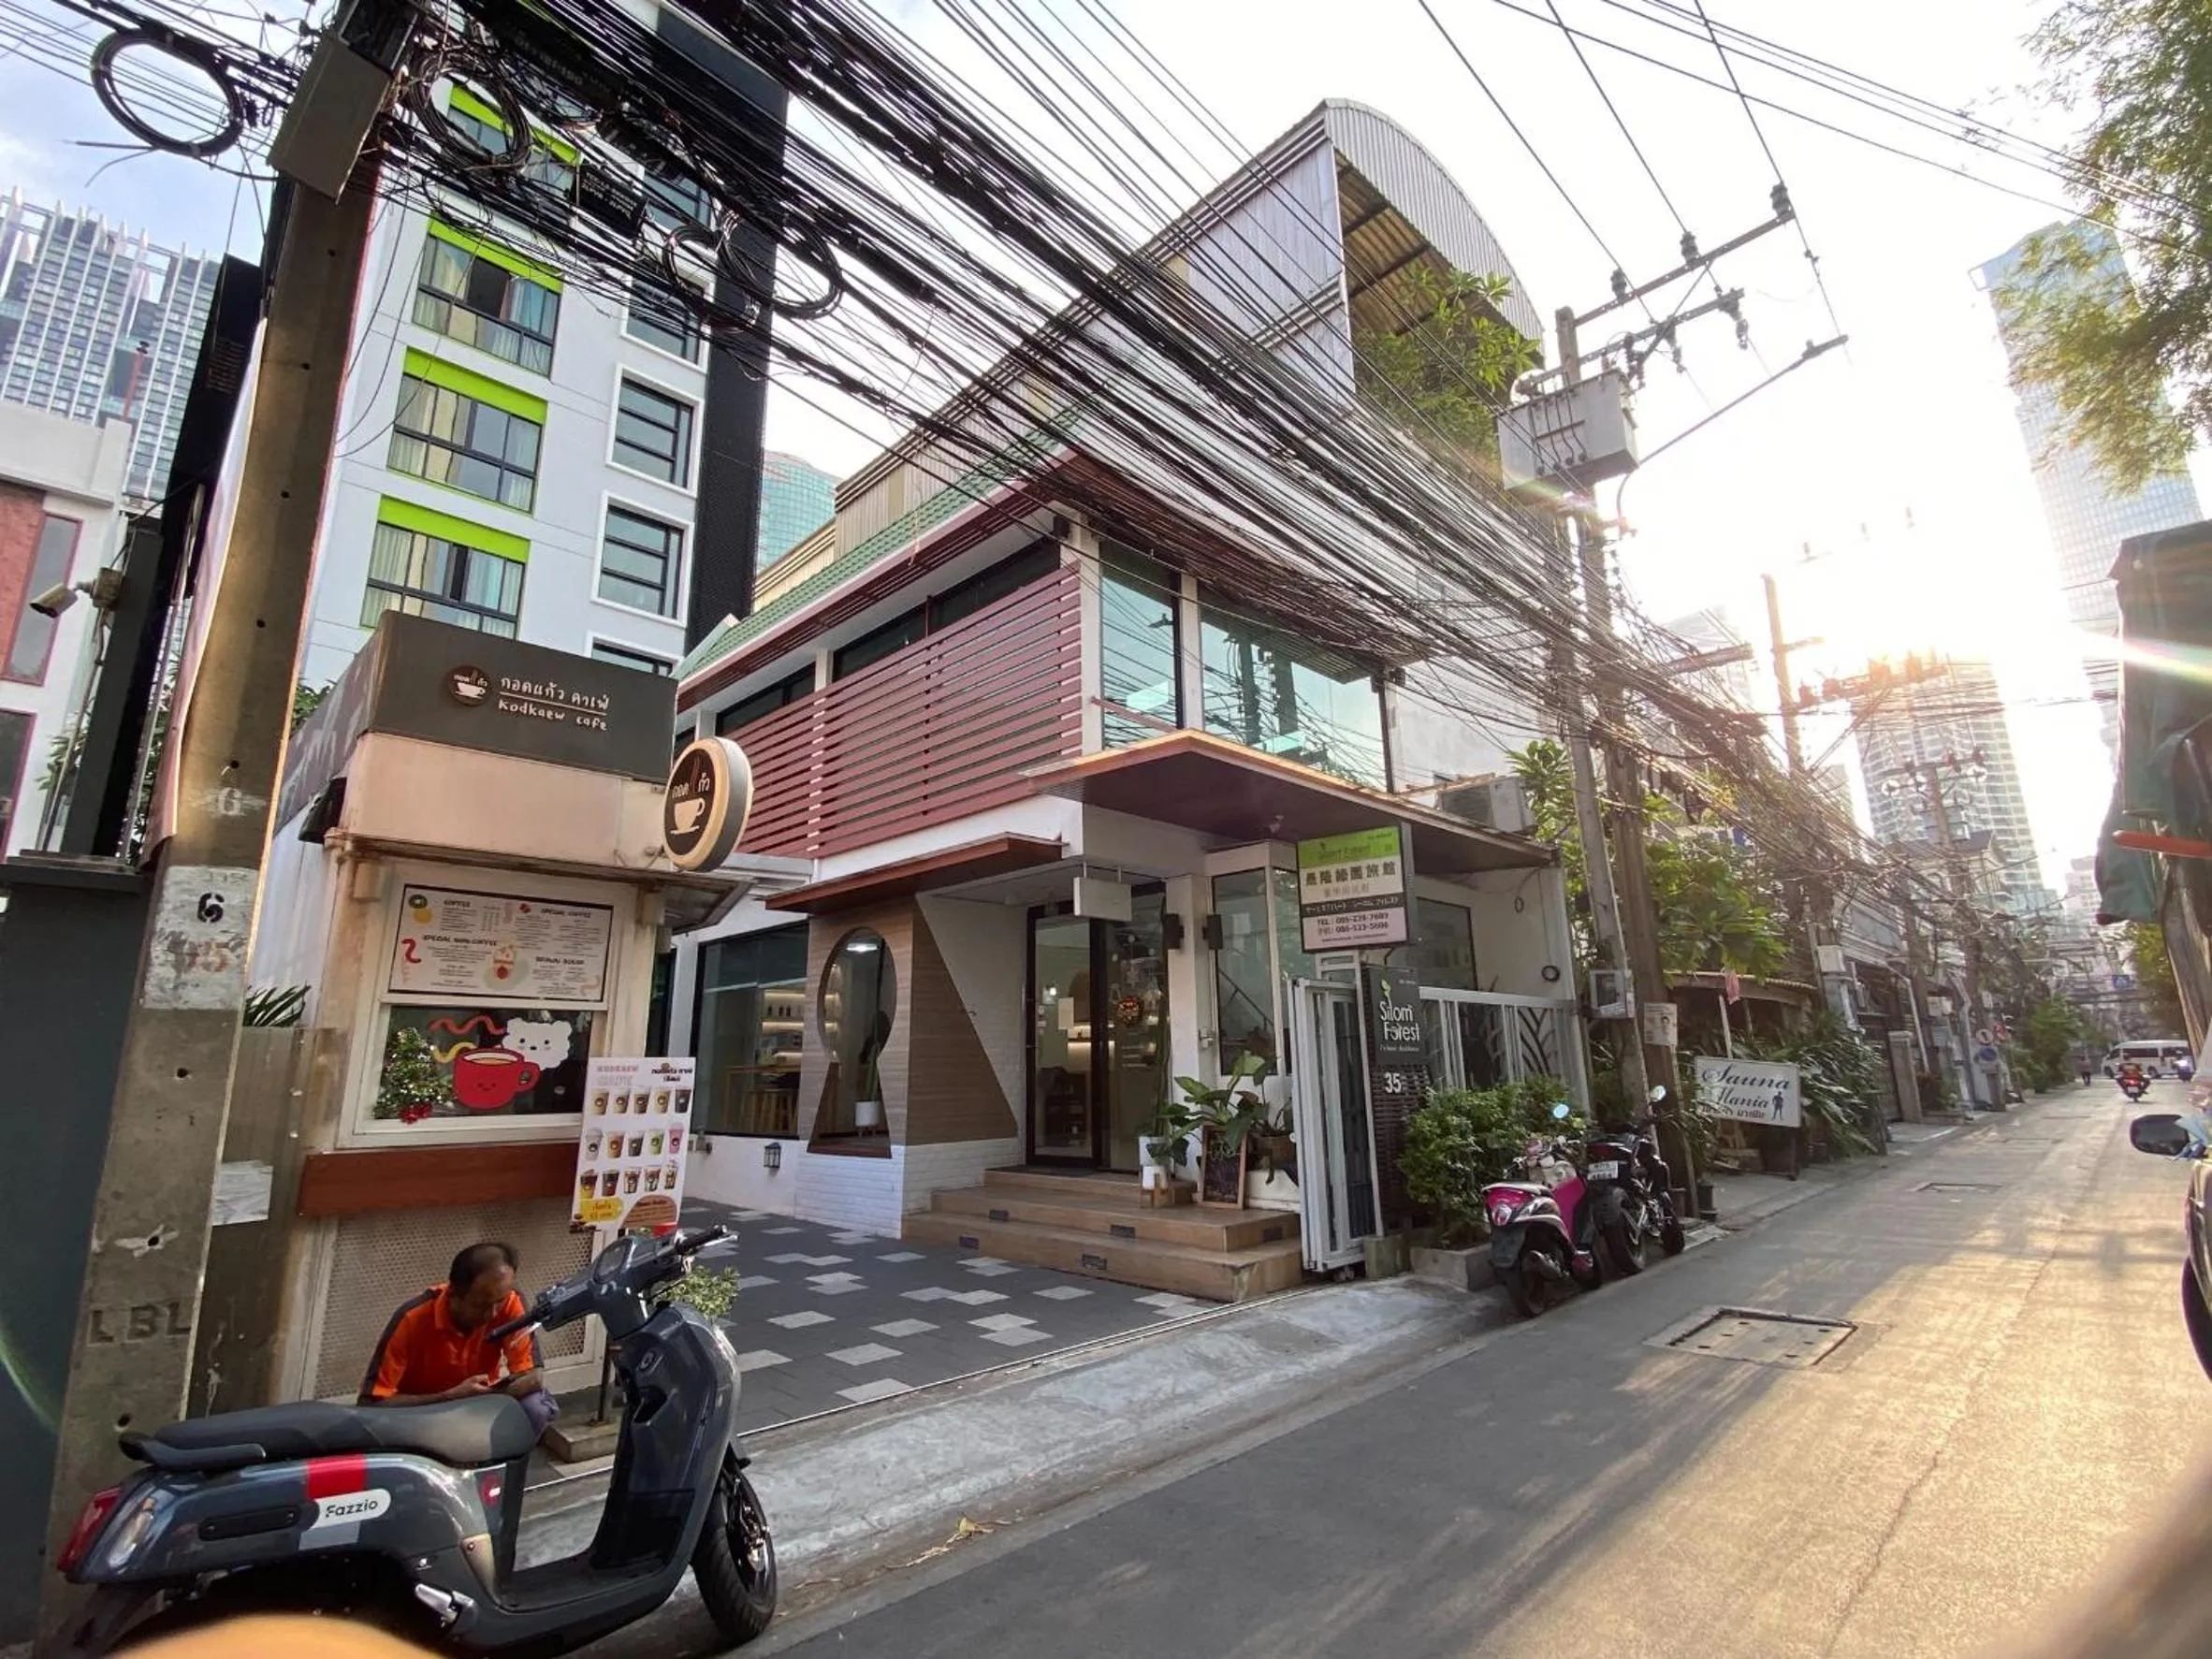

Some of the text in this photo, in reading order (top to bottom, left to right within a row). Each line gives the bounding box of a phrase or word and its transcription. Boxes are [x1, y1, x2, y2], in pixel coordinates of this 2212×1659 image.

[501, 677, 609, 710] กอดแก้ว คาเฟ่
[498, 699, 565, 720] Kodkaew
[197, 892, 225, 924] 6
[1379, 996, 1414, 1022] Silom
[1384, 1022, 1419, 1041] Forest
[1385, 1071, 1402, 1094] 35
[1702, 1064, 1790, 1089] Sauna
[325, 1499, 379, 1518] Fazzio
